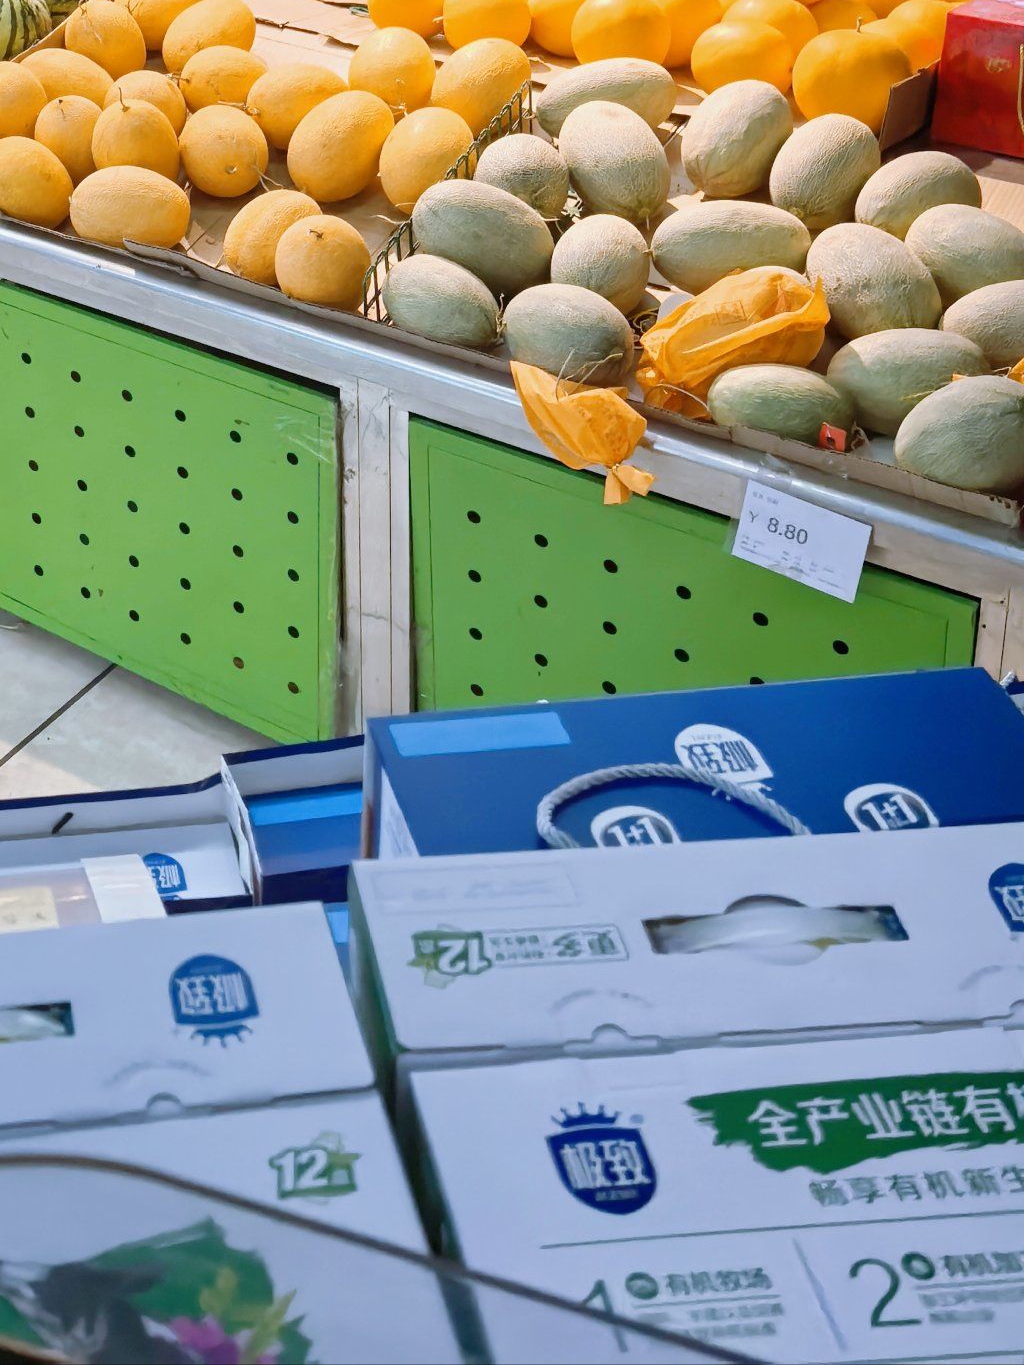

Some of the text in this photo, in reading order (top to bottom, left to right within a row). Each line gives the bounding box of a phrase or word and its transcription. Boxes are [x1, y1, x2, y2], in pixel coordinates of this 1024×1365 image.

[767, 517, 808, 545] 8.80
[438, 933, 492, 975] 12
[277, 1148, 329, 1191] 12
[848, 1257, 924, 1329] 2
